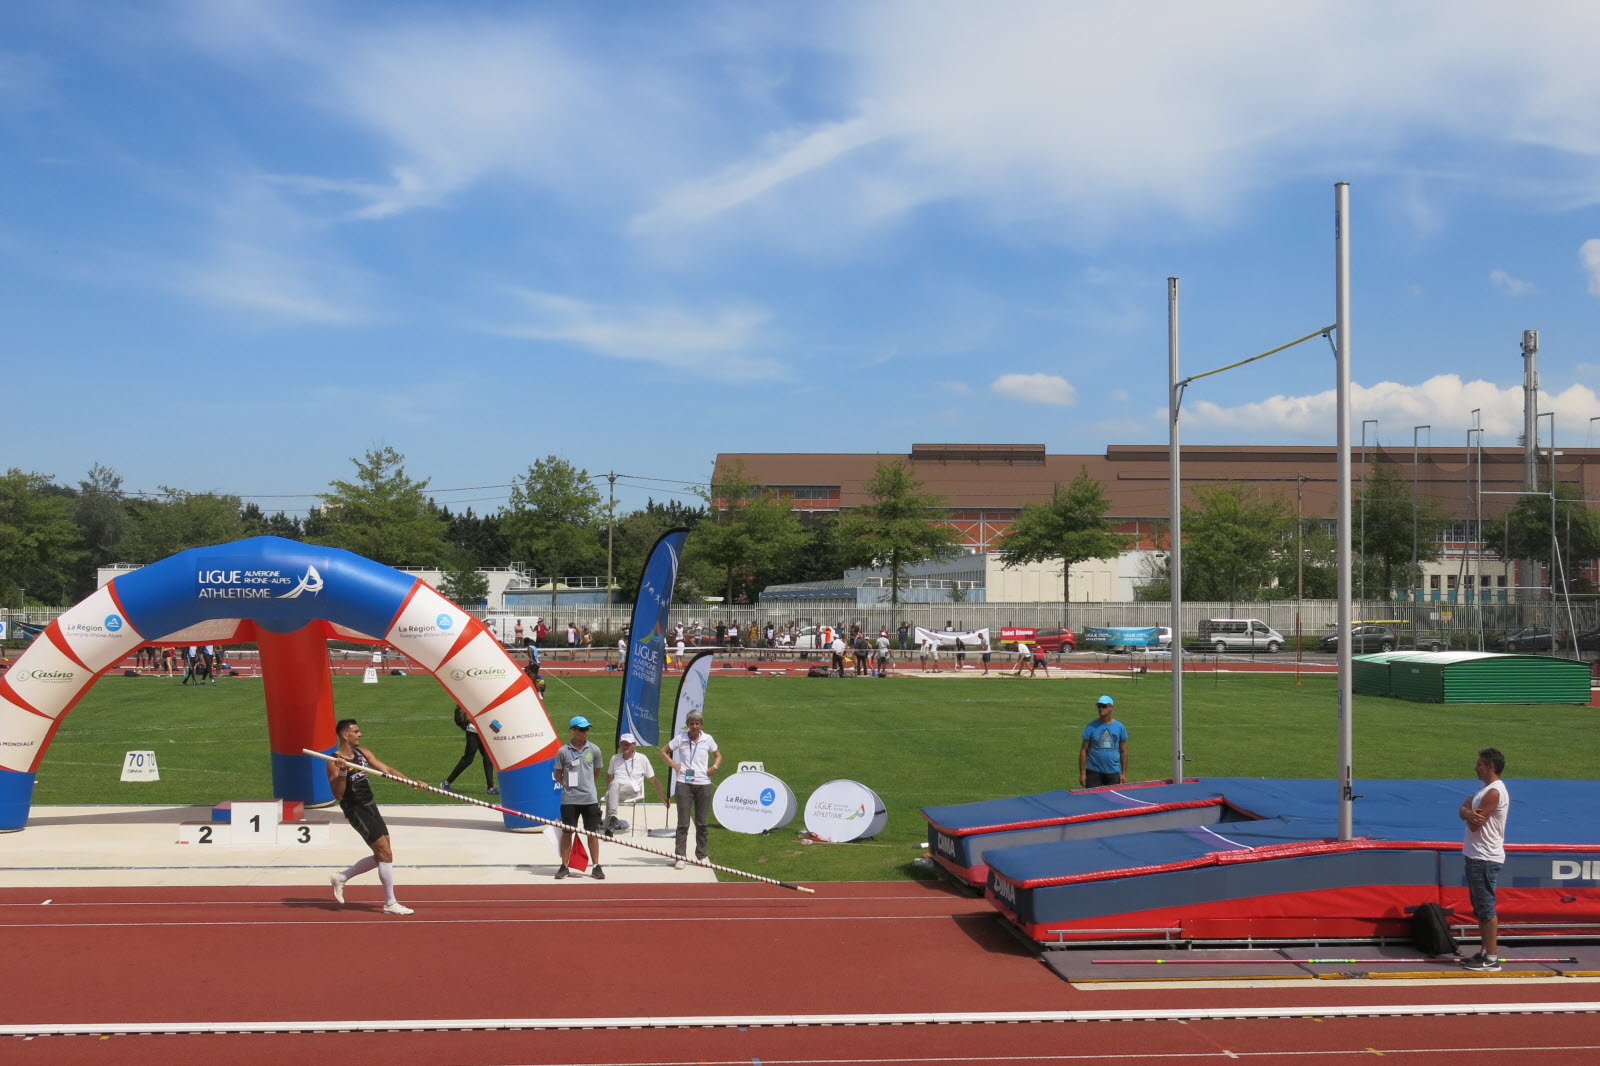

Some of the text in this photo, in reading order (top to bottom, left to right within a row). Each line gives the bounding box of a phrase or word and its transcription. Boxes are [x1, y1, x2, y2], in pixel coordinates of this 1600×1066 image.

[198, 570, 241, 584] LIGUE
[198, 587, 271, 599] ATHLETISME
[77, 623, 103, 632] Région
[409, 625, 436, 633] Région
[634, 643, 659, 664] LIGUE
[31, 669, 74, 680] Casino
[466, 666, 507, 678] Casino
[129, 753, 144, 767] 70
[735, 797, 758, 805] Région
[814, 802, 833, 810] LIGUE
[249, 814, 260, 833] 1
[199, 826, 213, 844] 2
[297, 826, 311, 844] 3
[938, 832, 956, 858] DIMA
[1552, 860, 1600, 880] DI
[993, 873, 1016, 905] DIMA
